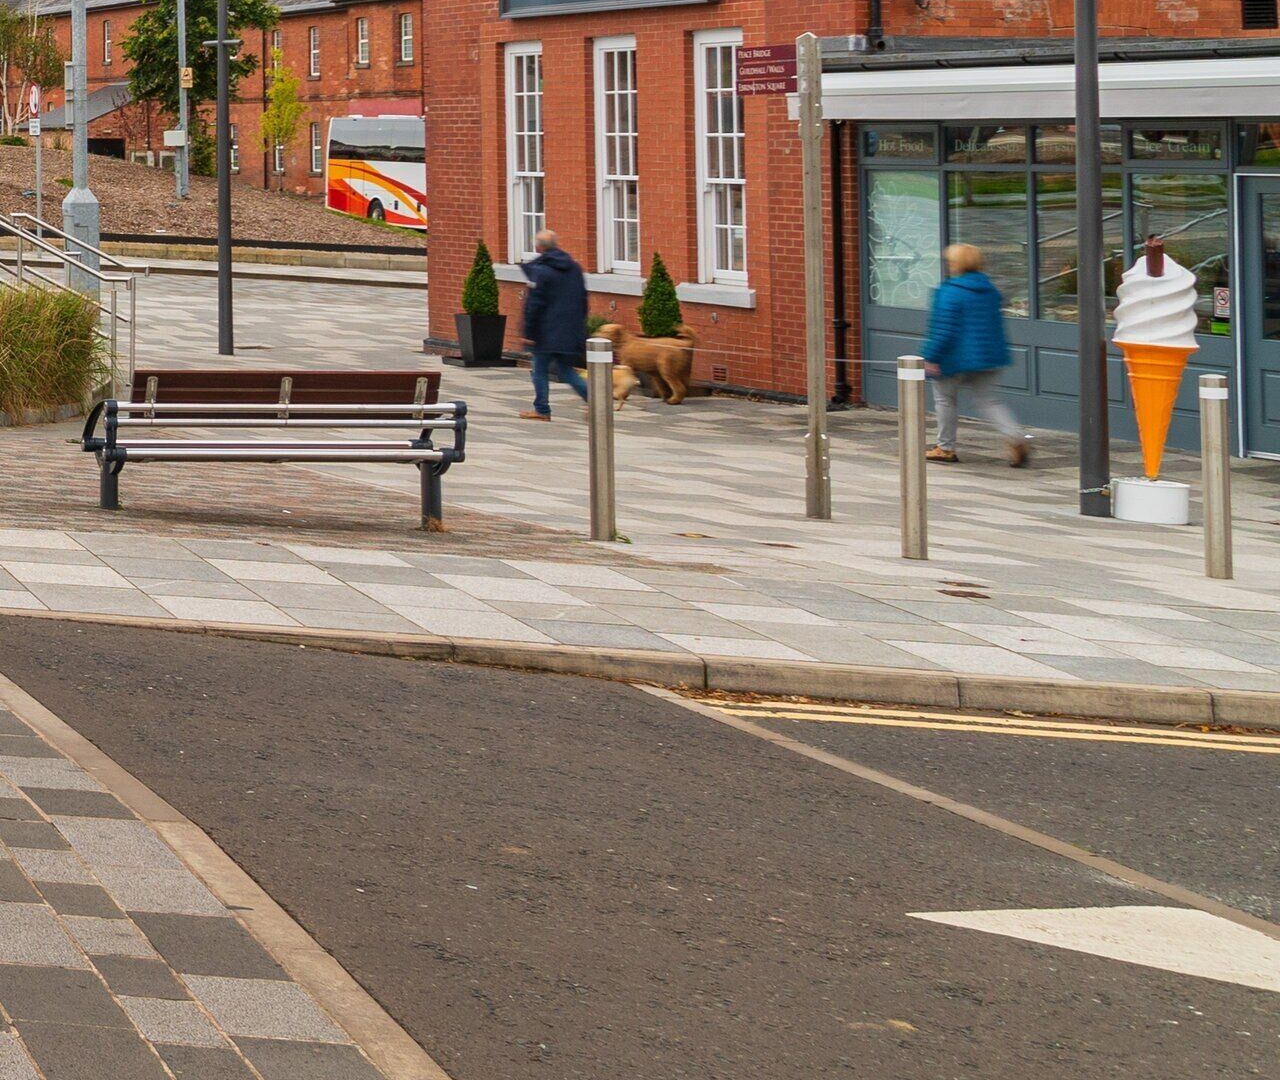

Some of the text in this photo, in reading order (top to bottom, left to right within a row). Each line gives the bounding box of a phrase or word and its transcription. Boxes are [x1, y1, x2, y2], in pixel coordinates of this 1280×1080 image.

[878, 139, 925, 153] Hot Food
[1144, 140, 1211, 154] Ice Cream
